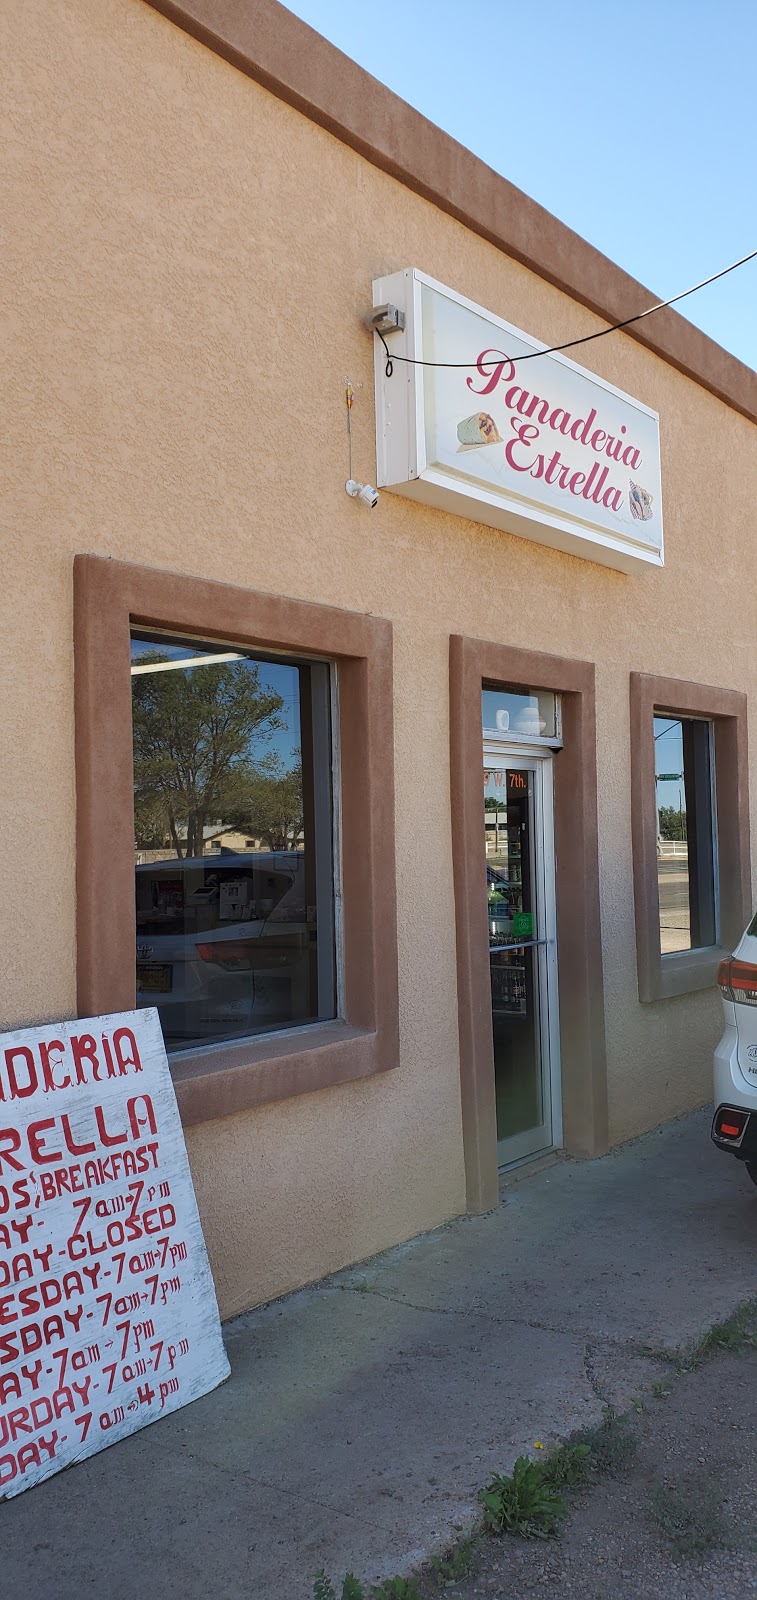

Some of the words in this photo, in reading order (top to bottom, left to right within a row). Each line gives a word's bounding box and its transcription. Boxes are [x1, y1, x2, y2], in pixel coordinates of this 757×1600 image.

[466, 349, 643, 470] Panaderia
[505, 416, 624, 511] Estrella
[509, 773, 527, 788] 7th.
